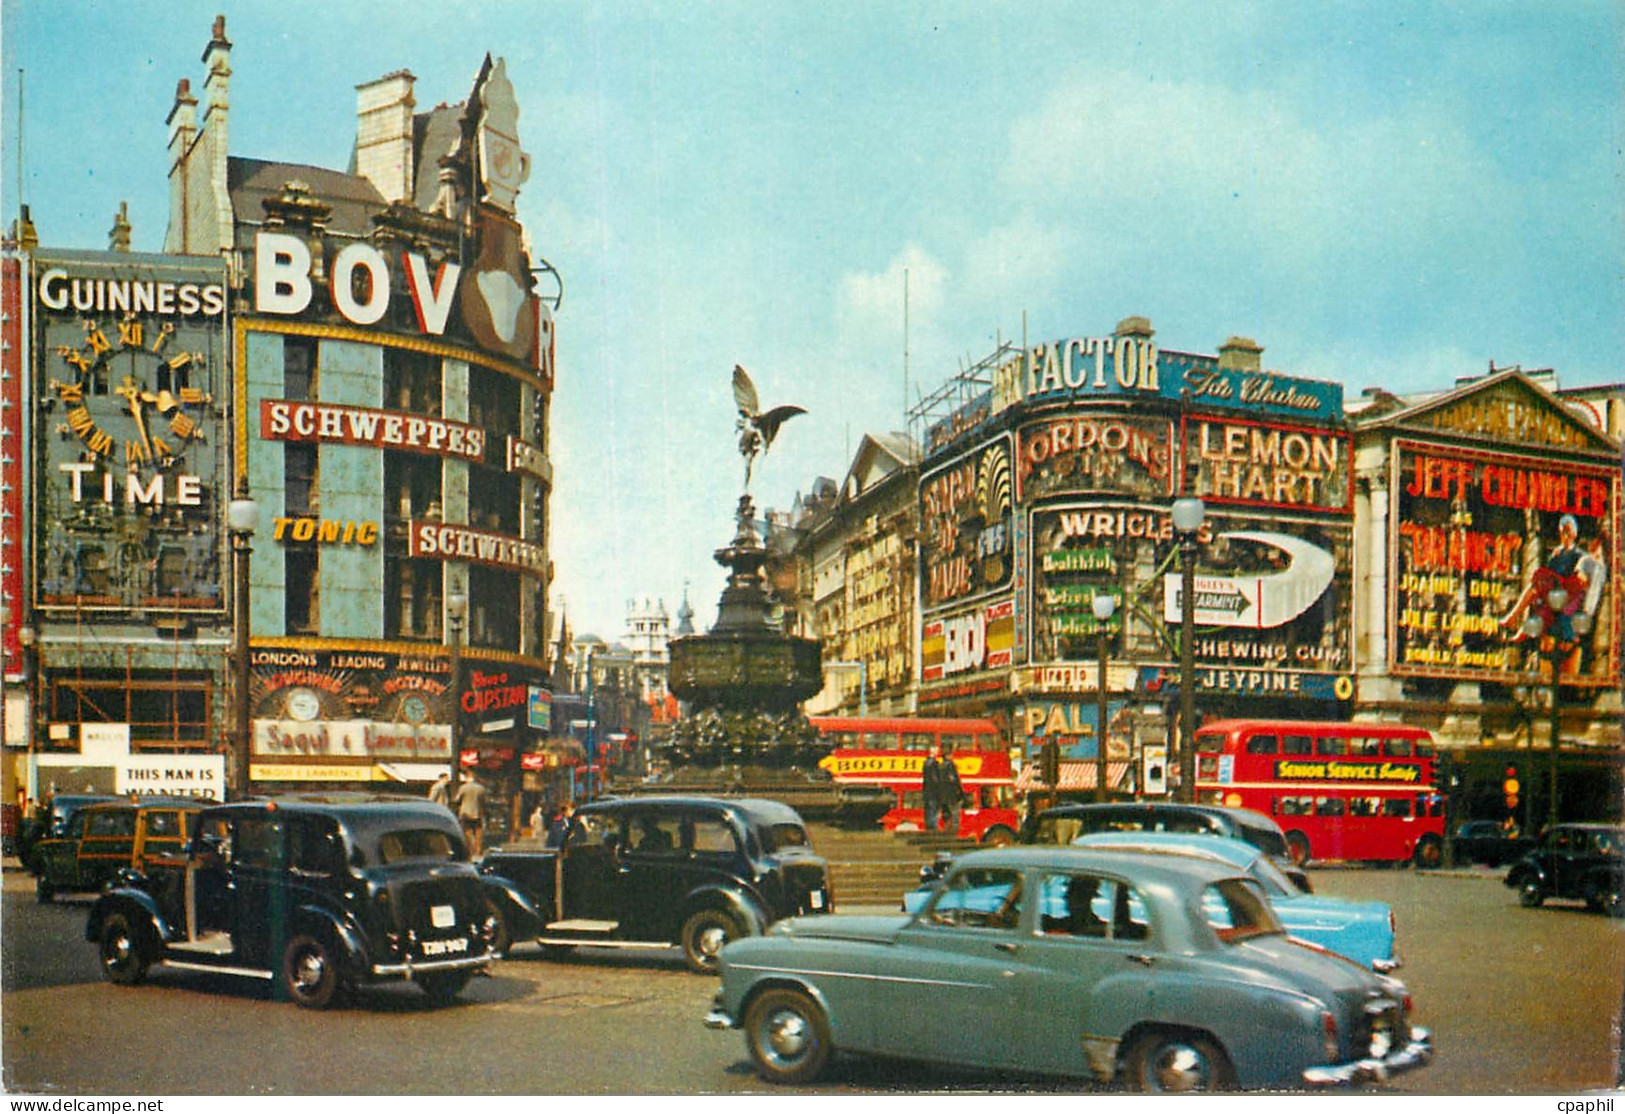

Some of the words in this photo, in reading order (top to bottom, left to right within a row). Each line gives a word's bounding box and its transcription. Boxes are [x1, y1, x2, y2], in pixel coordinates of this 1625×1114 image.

[39, 268, 223, 316] GUINNESS
[1026, 335, 1160, 396] FACTOR
[270, 404, 483, 456] SCHWEPPES
[1200, 422, 1340, 472] LEMON
[59, 463, 202, 505] TIME
[1212, 459, 1324, 504] HART
[1407, 456, 1475, 499] JEFF
[1482, 465, 1608, 518] CHANDLER
[272, 516, 379, 545] TONIC
[1401, 574, 1457, 596] JOANNE
[1469, 580, 1502, 599] DRU
[1442, 611, 1500, 634] LONDON
[330, 655, 386, 670] LEADING
[1193, 640, 1288, 660] HEWING
[1296, 645, 1342, 664] GUM
[1203, 671, 1300, 691] JEYPINE
[1025, 703, 1095, 736] PAL
[127, 768, 159, 780] THIS
[165, 769, 193, 780] MAN
[200, 769, 213, 780] IS
[1278, 761, 1325, 779] SENIOR
[1327, 762, 1377, 780] SERVICE
